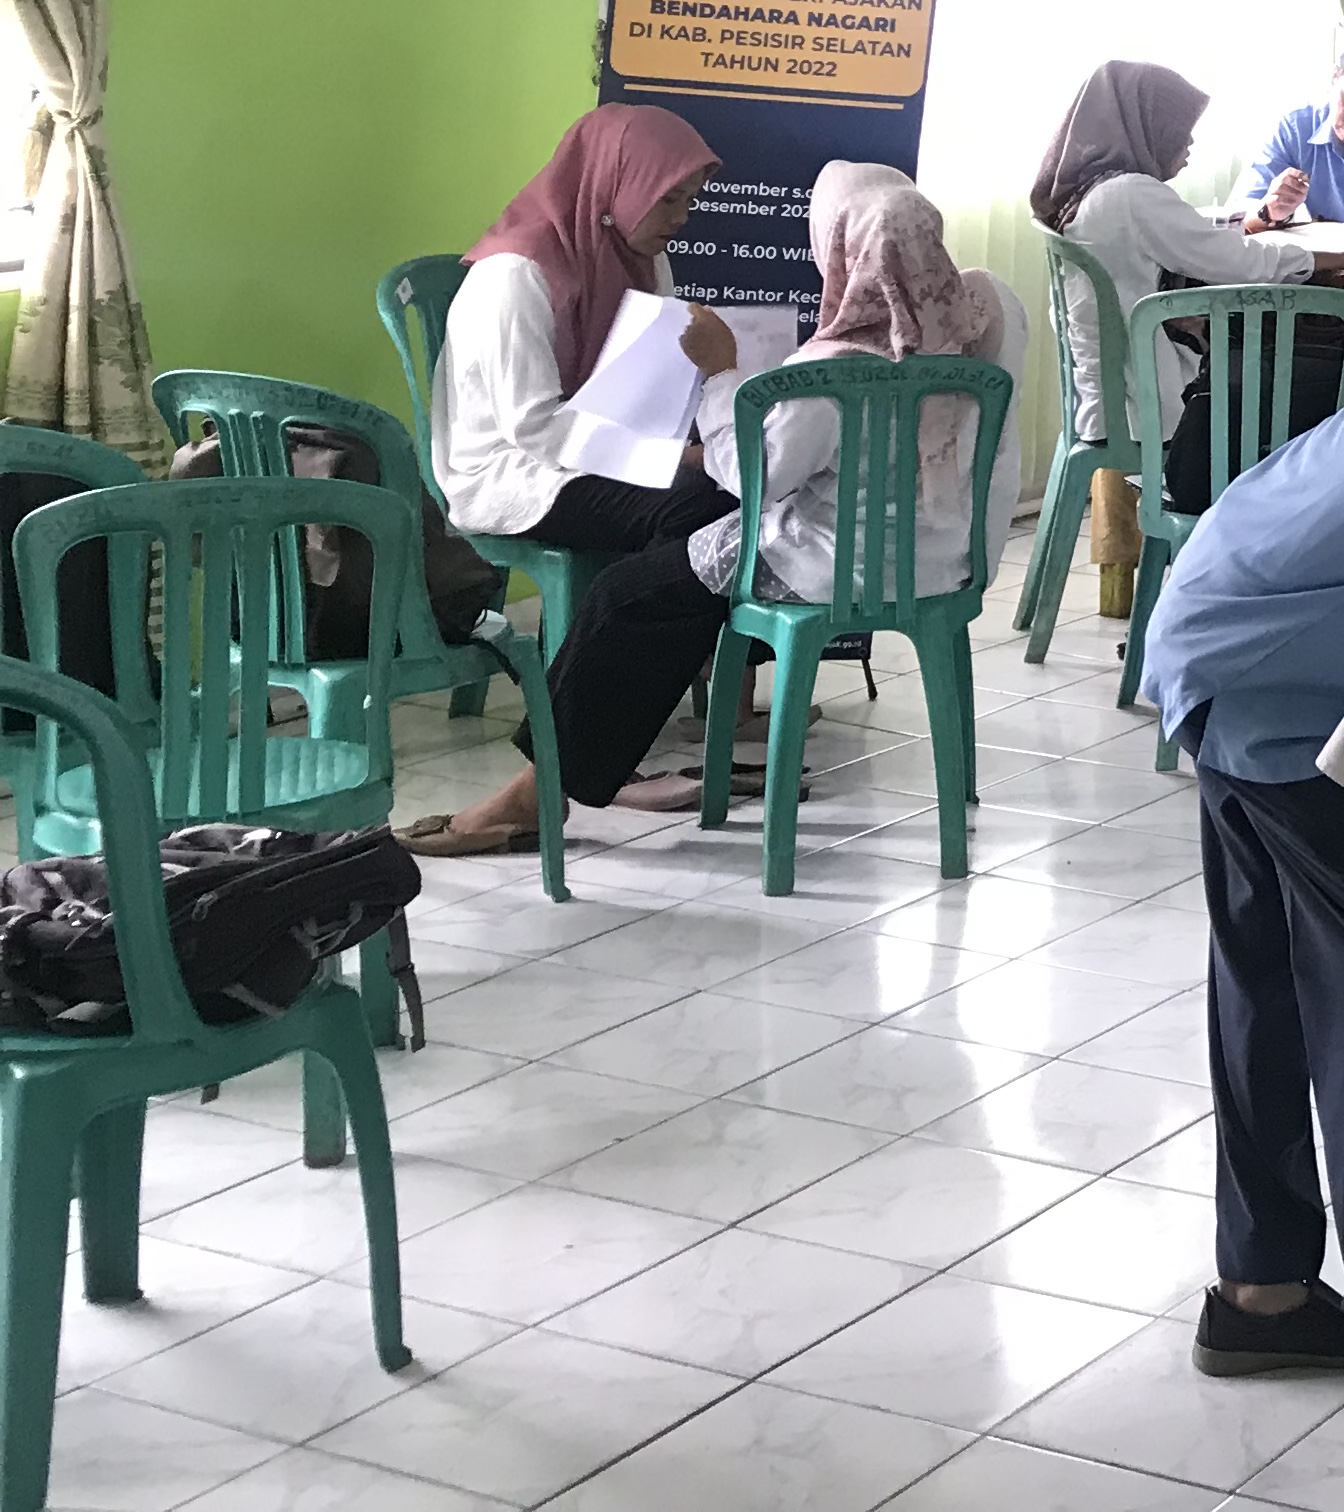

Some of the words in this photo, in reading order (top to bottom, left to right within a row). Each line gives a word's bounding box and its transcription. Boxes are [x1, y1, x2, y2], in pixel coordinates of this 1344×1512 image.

[807, 11, 897, 34] NAGARI
[629, 21, 653, 38] DI
[660, 24, 713, 44] KAB.
[720, 28, 806, 50] PESISIR
[811, 36, 912, 59] SELATAN
[701, 51, 779, 73] TAHUN
[786, 58, 838, 78] 2022
[666, 240, 717, 256] 09.00
[732, 244, 777, 260] 16.00
[723, 286, 784, 303] Kantor
